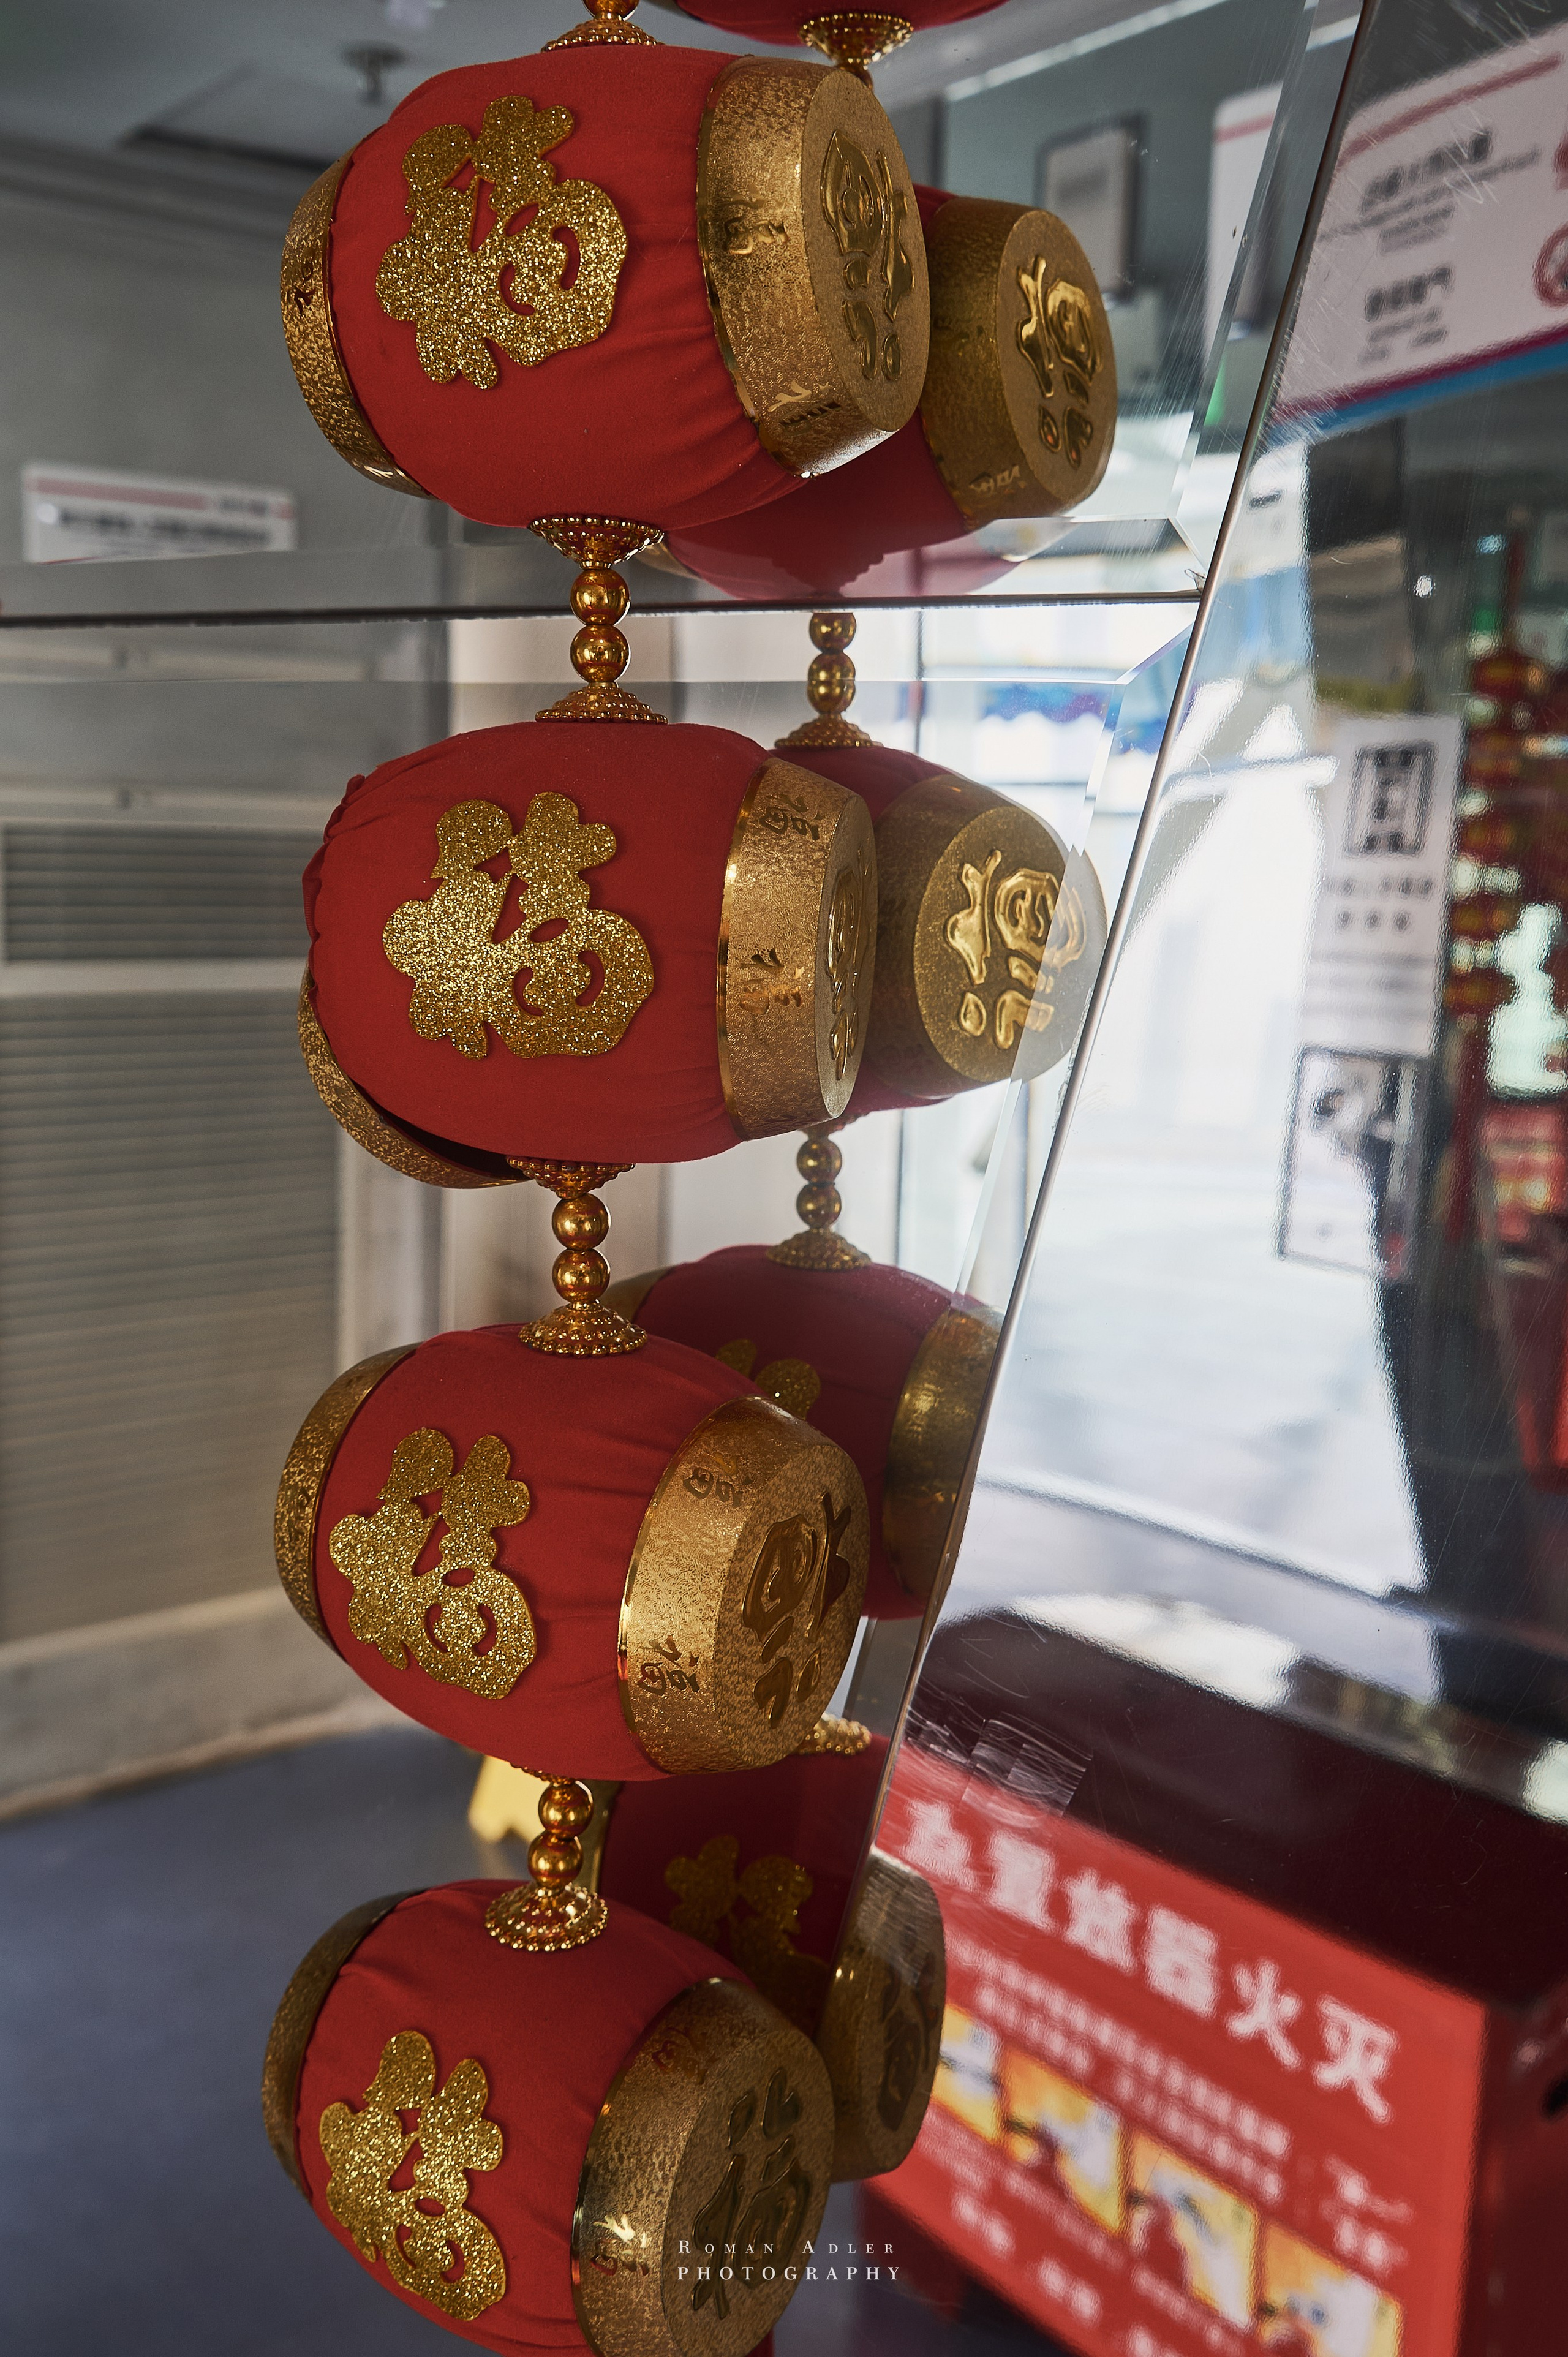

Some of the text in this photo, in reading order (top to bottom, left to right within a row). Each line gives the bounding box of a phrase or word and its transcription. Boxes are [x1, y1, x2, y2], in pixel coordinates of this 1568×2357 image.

[376, 95, 627, 390] 福
[382, 791, 654, 1059] 福
[329, 1428, 537, 1699] 福
[319, 2030, 506, 2320] 福
